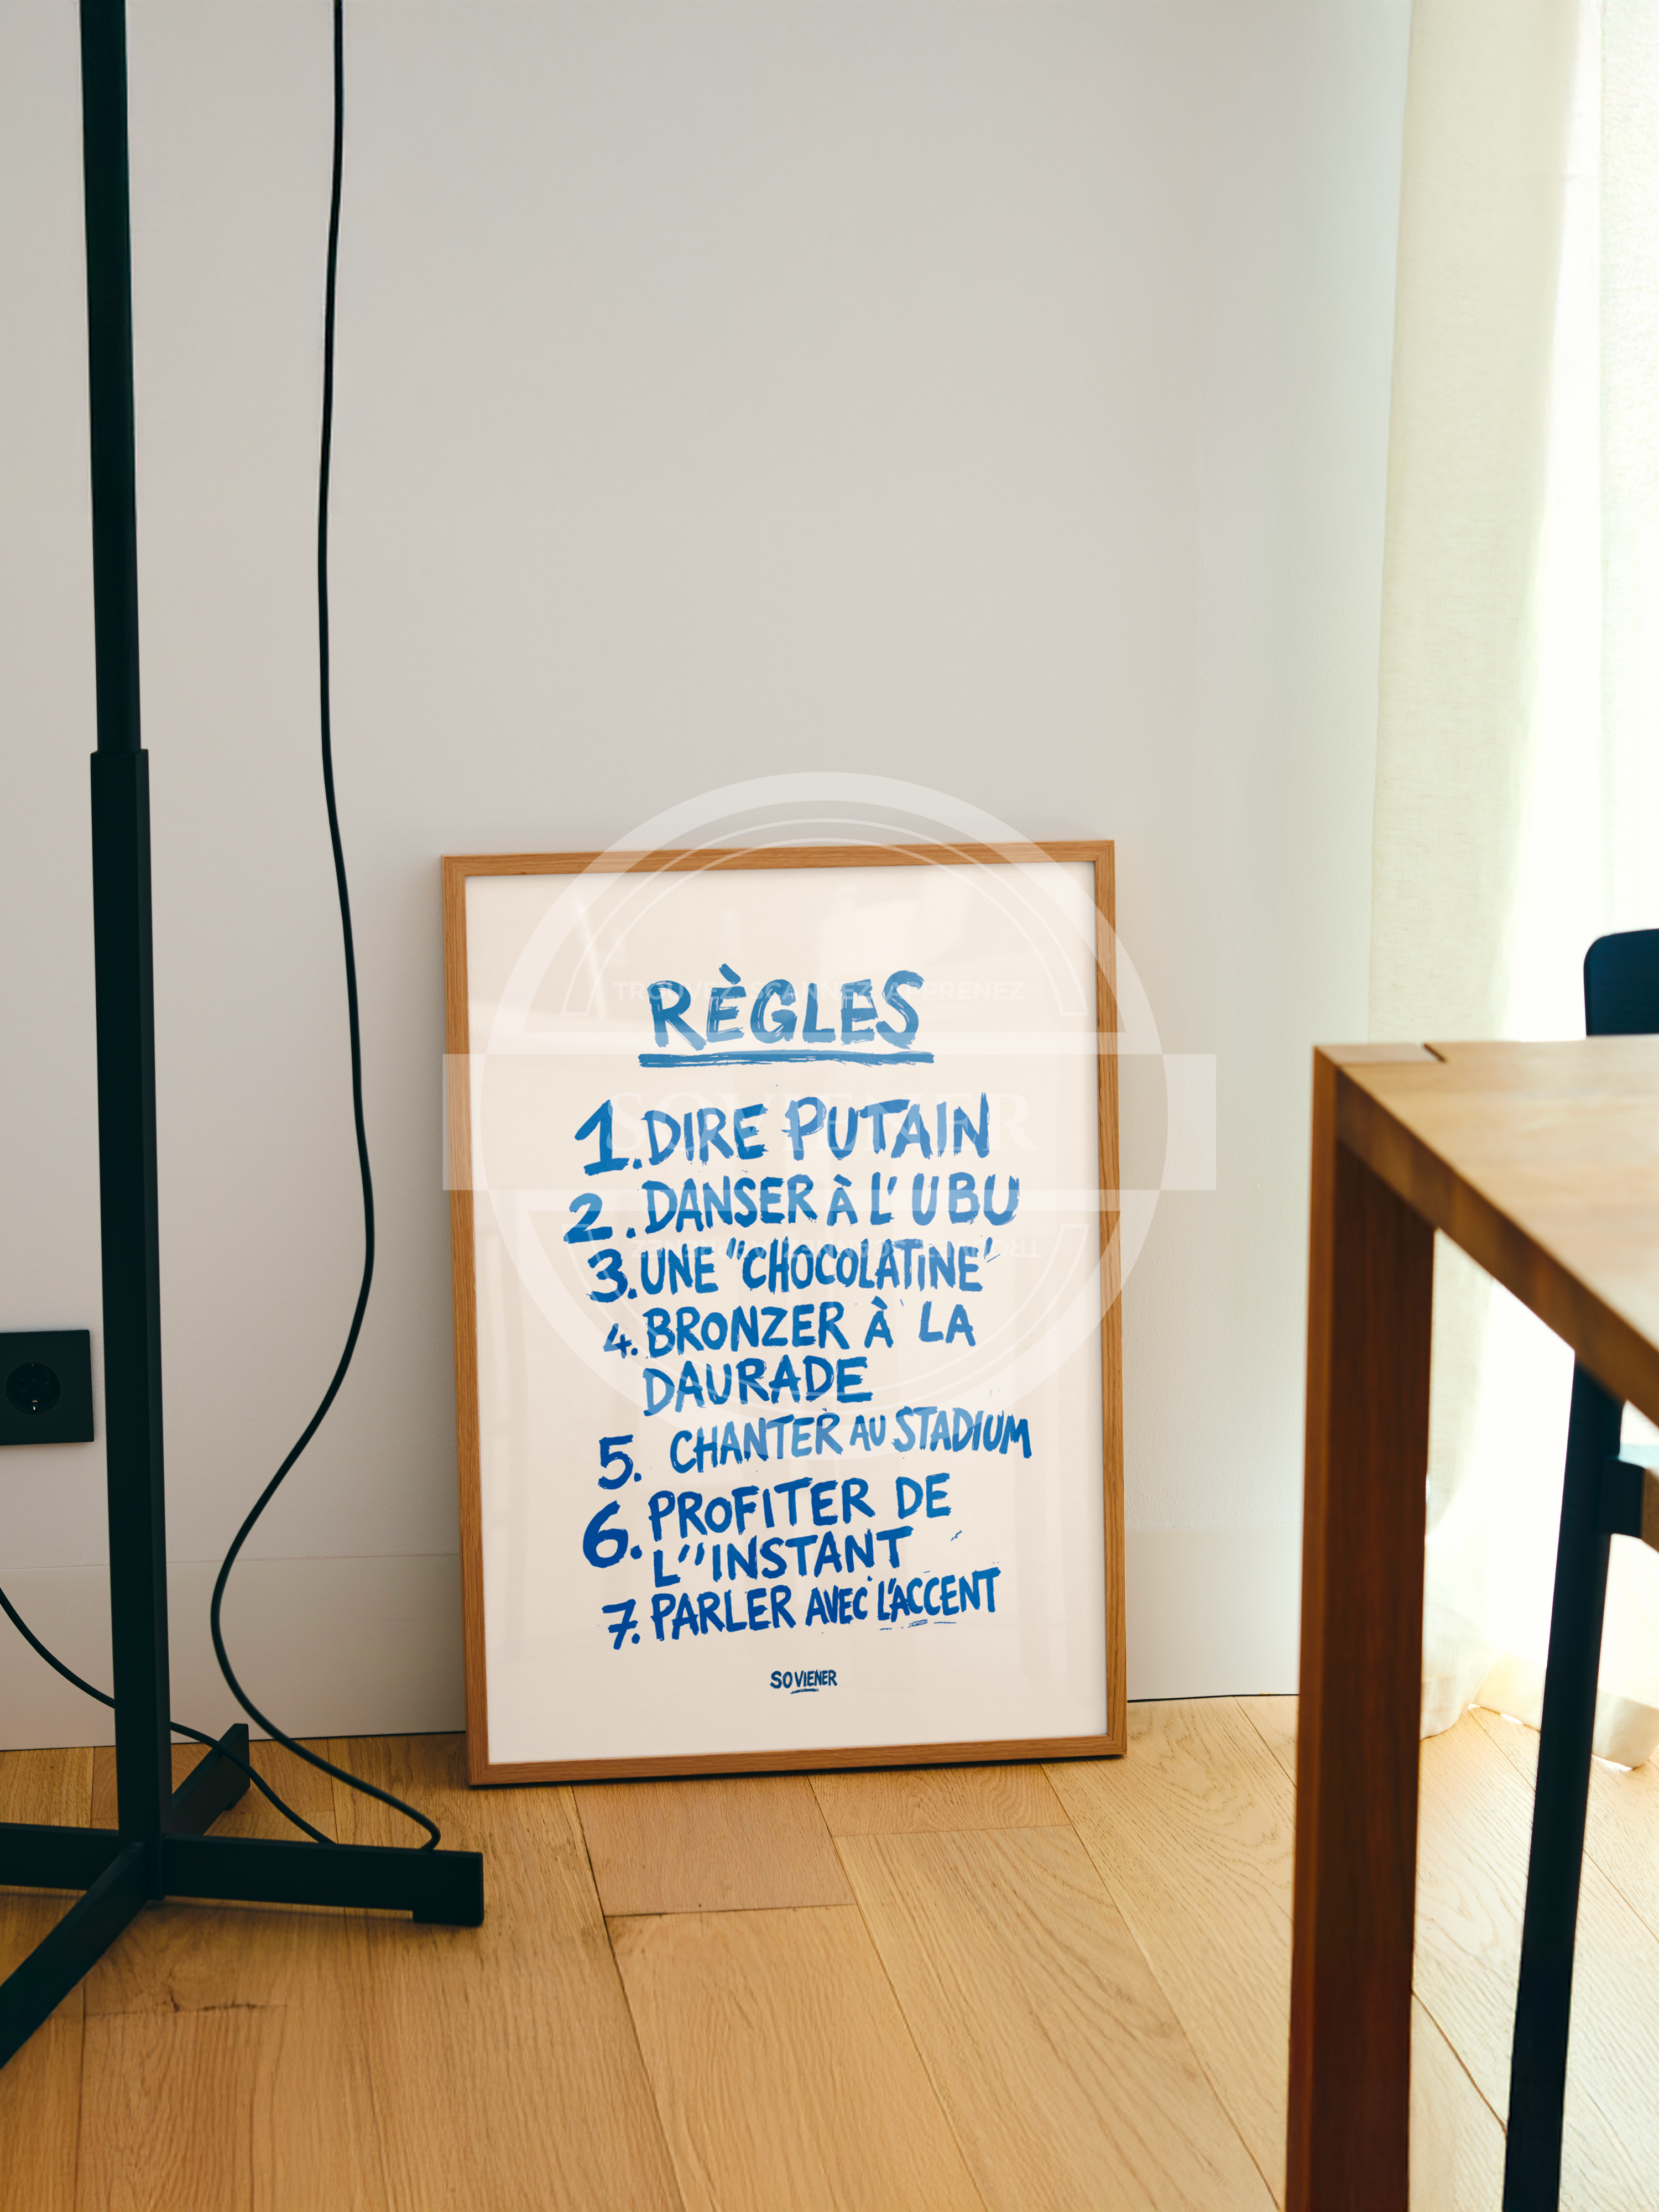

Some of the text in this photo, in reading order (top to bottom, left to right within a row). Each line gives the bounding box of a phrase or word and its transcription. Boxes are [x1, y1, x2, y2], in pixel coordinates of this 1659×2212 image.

[646, 963, 925, 1051] RÈGLES
[641, 1103, 769, 1166] DIRE
[781, 1092, 990, 1161] PUTAIN
[563, 1192, 637, 1244] 2.
[641, 1173, 818, 1235] DANSER
[826, 1173, 858, 1227] À
[586, 1248, 638, 1303] 3.
[640, 1243, 719, 1296] UNE
[603, 1295, 976, 1359] 4. BRONZER À LA
[642, 1355, 874, 1417] DAURADE
[597, 1406, 1032, 1490] 5. CHANTER AU STADIUM
[582, 1472, 952, 1569] 6. PROFITER DE
[601, 1567, 1001, 1650] 7. PARLER AVEC L'ACCENT
